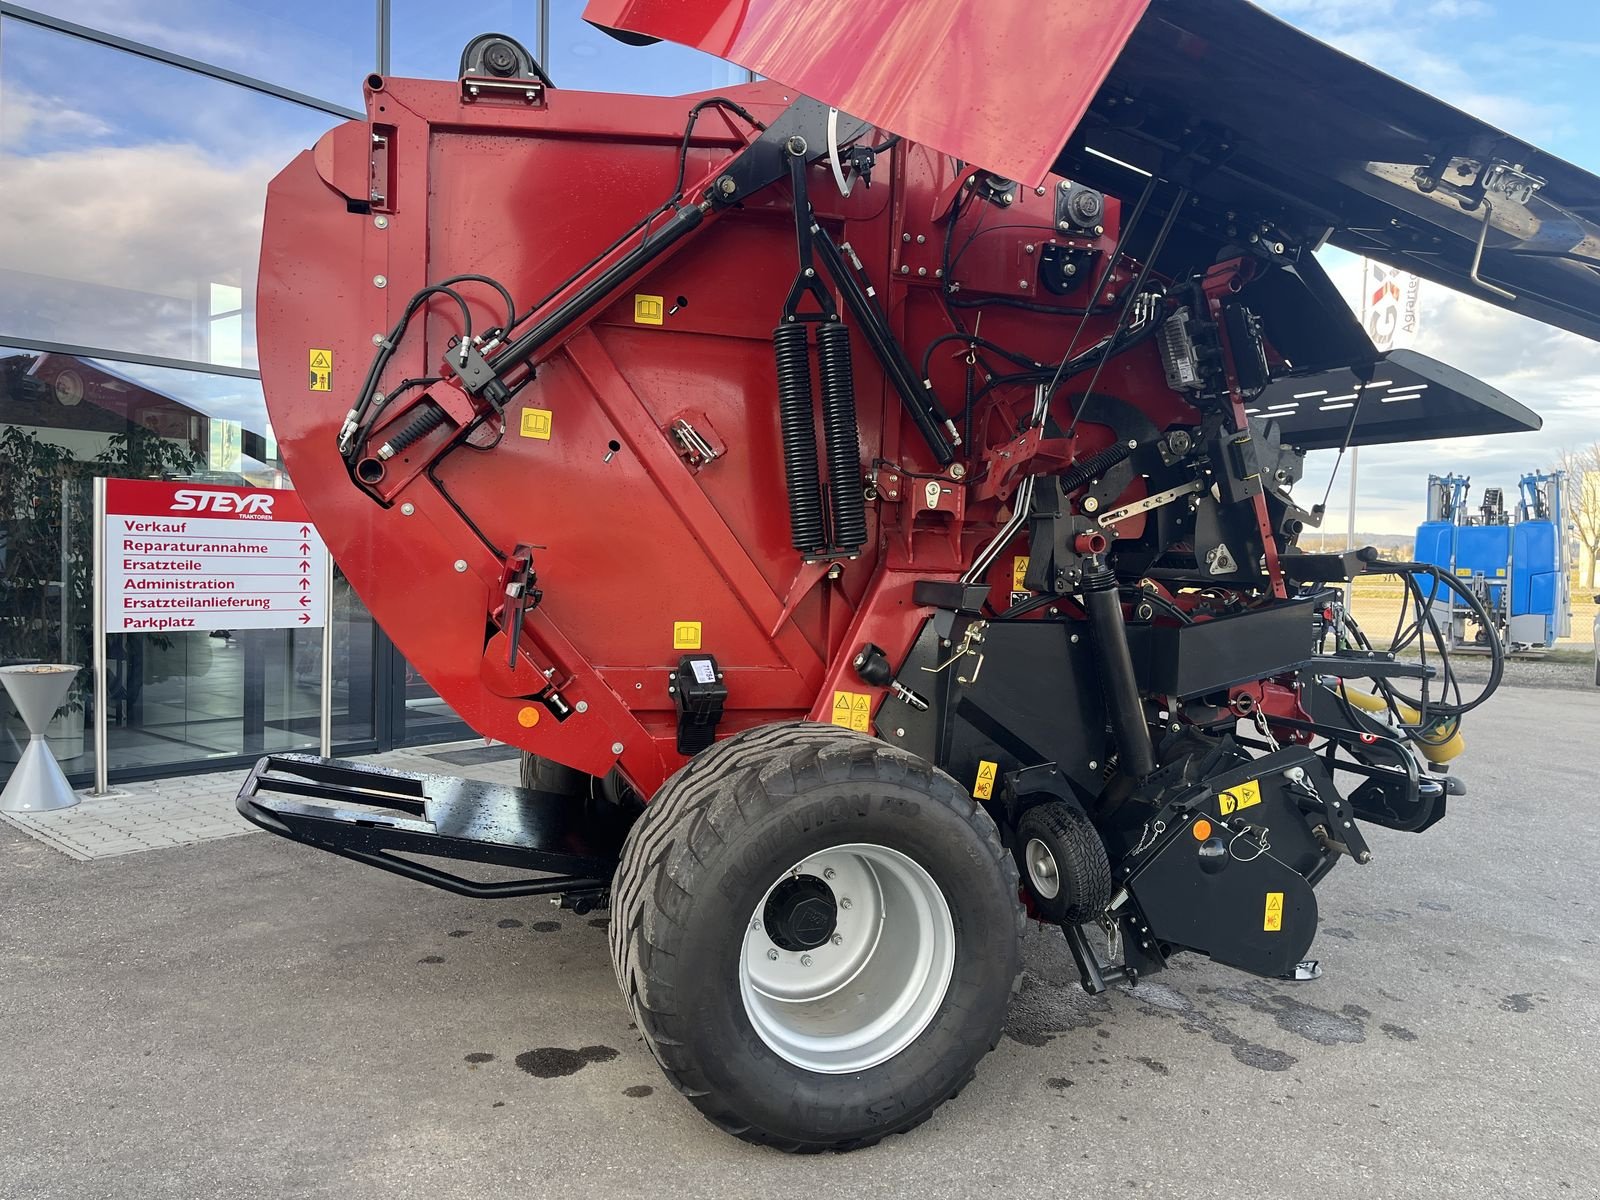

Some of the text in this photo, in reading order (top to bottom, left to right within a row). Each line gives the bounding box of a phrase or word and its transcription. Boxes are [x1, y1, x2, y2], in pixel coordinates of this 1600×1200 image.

[170, 489, 274, 514] STEYR
[239, 513, 273, 521] TRAKTOREN
[124, 520, 187, 533] Verkauf
[123, 539, 268, 553] Reparaturannahme
[123, 559, 202, 571] Ersatzteile
[124, 578, 235, 590] Administration
[123, 596, 271, 610] Ersatzteilanlieferung
[123, 616, 195, 631] Parkplatz
[718, 793, 871, 903] FLOTATION
